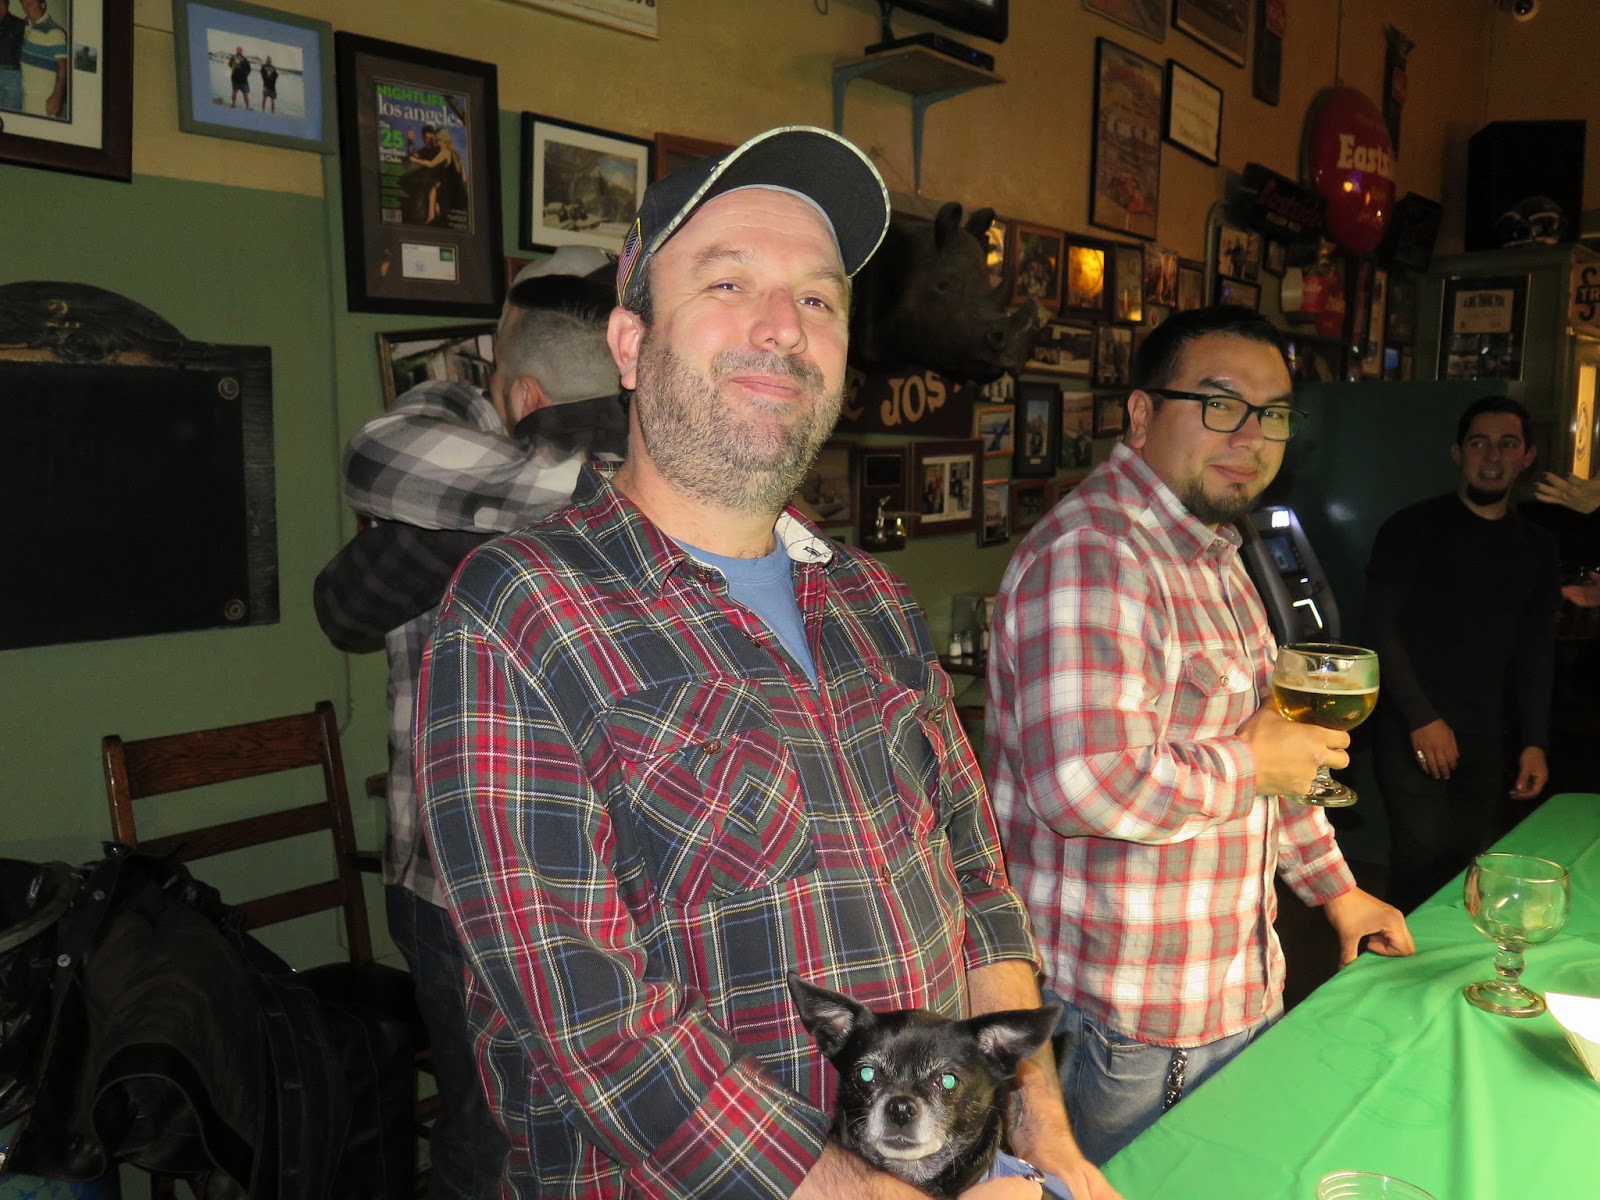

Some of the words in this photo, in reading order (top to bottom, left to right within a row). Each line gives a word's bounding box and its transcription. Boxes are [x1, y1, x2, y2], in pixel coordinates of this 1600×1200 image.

[378, 93, 402, 117] los
[404, 105, 464, 129] angeles
[381, 128, 403, 148] 25
[880, 369, 956, 428] JOS
